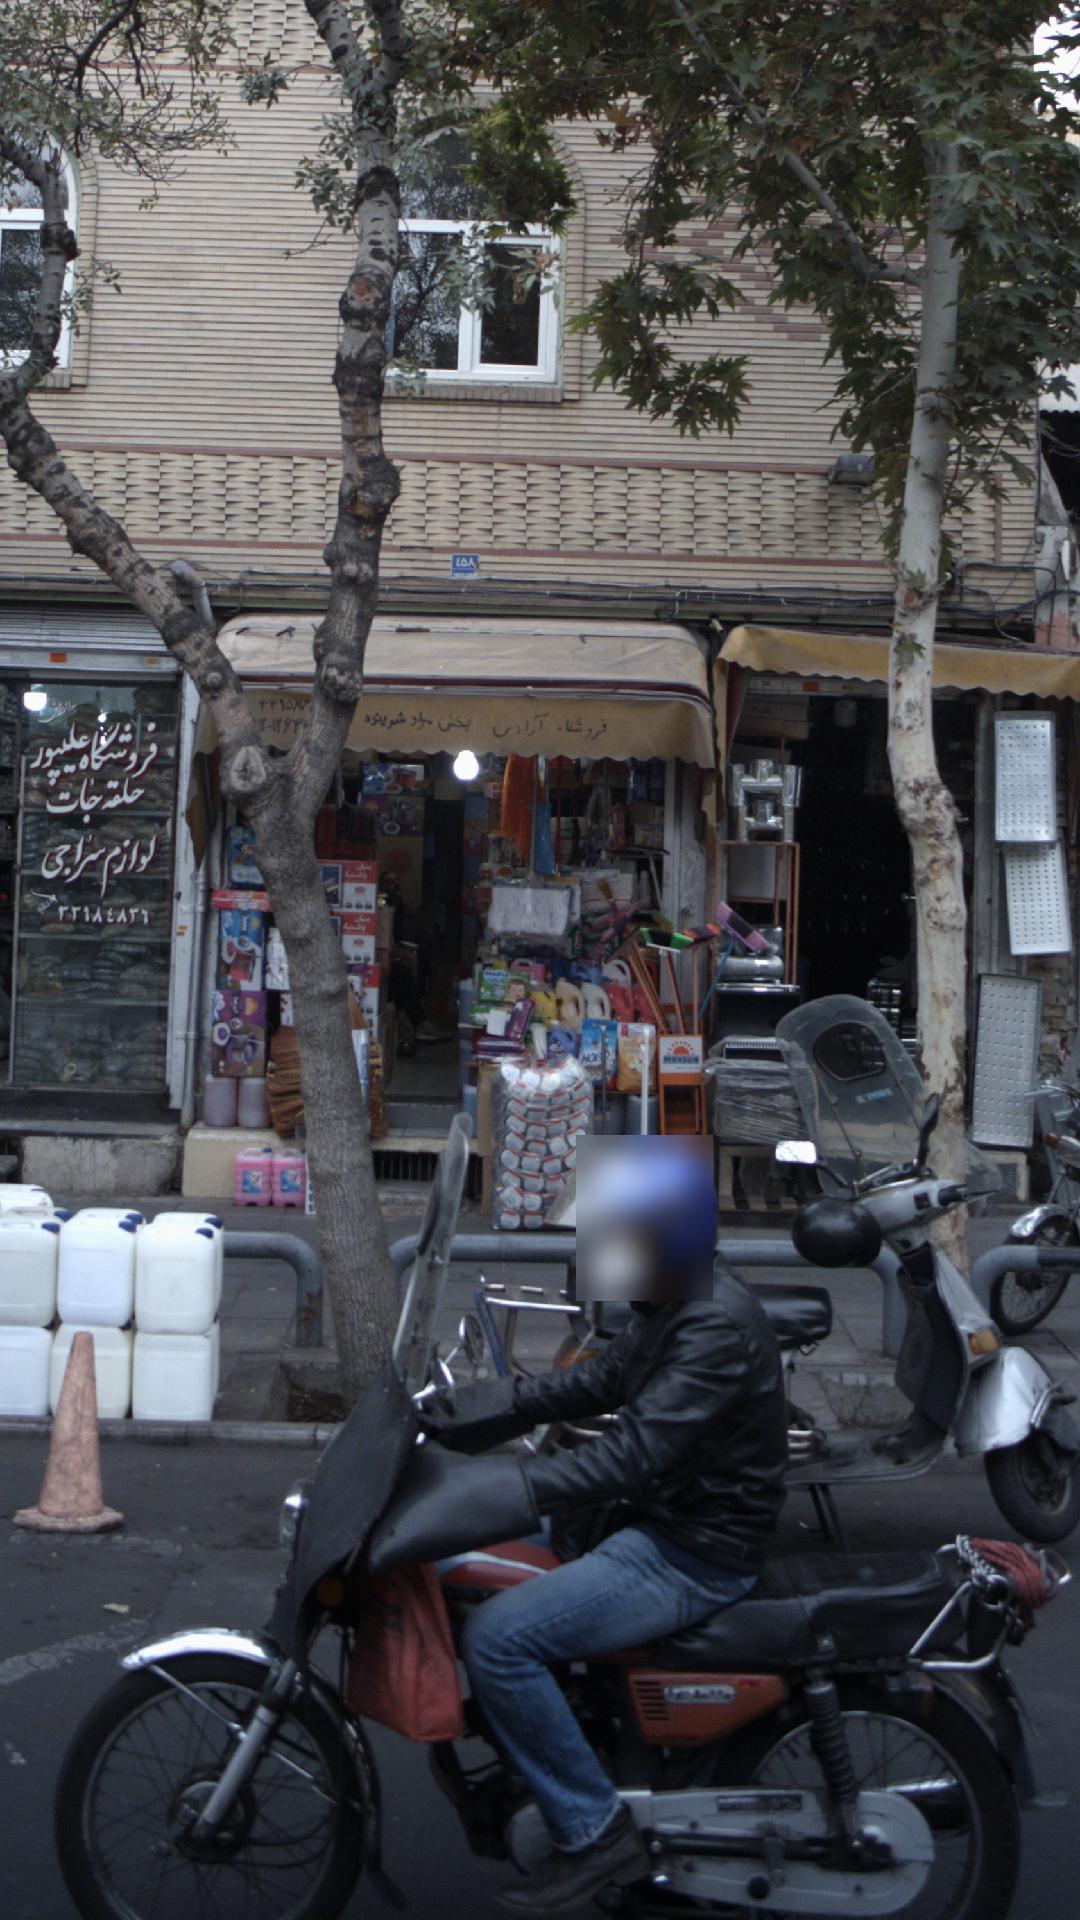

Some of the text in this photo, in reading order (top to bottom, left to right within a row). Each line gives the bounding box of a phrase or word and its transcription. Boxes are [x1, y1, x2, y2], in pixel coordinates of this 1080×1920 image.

[79, 721, 158, 778] فروشگاه
[46, 777, 145, 824] حلقه جات
[41, 834, 157, 898] لوازم سراجی
